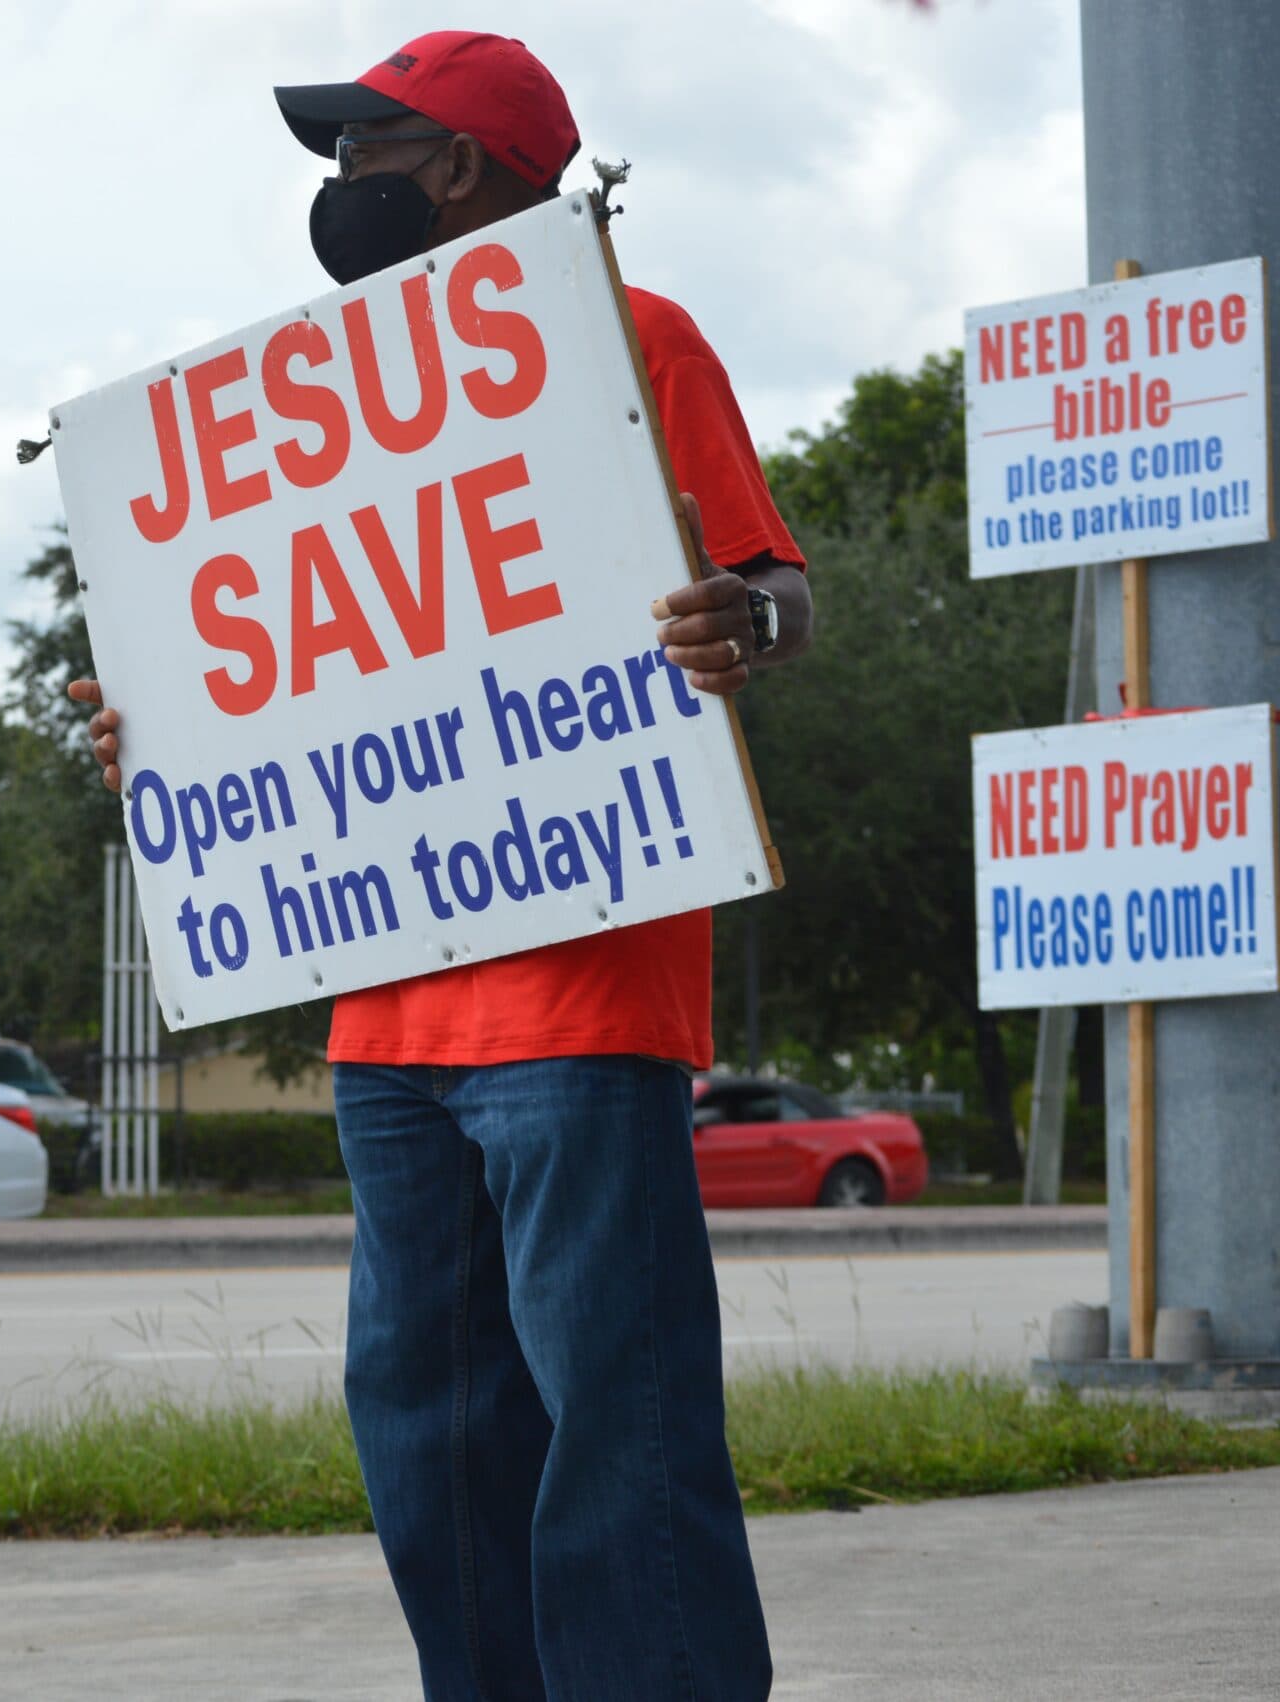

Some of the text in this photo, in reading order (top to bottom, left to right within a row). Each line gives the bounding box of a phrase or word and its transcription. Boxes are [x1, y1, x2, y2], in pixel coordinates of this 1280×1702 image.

[979, 293, 1246, 384] NEED a free
[129, 244, 548, 544] JESUS
[1053, 372, 1171, 442] bible
[985, 480, 1250, 548] to the parking lot!!
[1007, 436, 1223, 502] please come
[189, 453, 564, 717] SAVE
[129, 644, 702, 878] Open your heart
[990, 761, 1253, 860] NEED Prayer
[177, 756, 695, 978] to him today!!
[993, 865, 1257, 971] Please come!!
